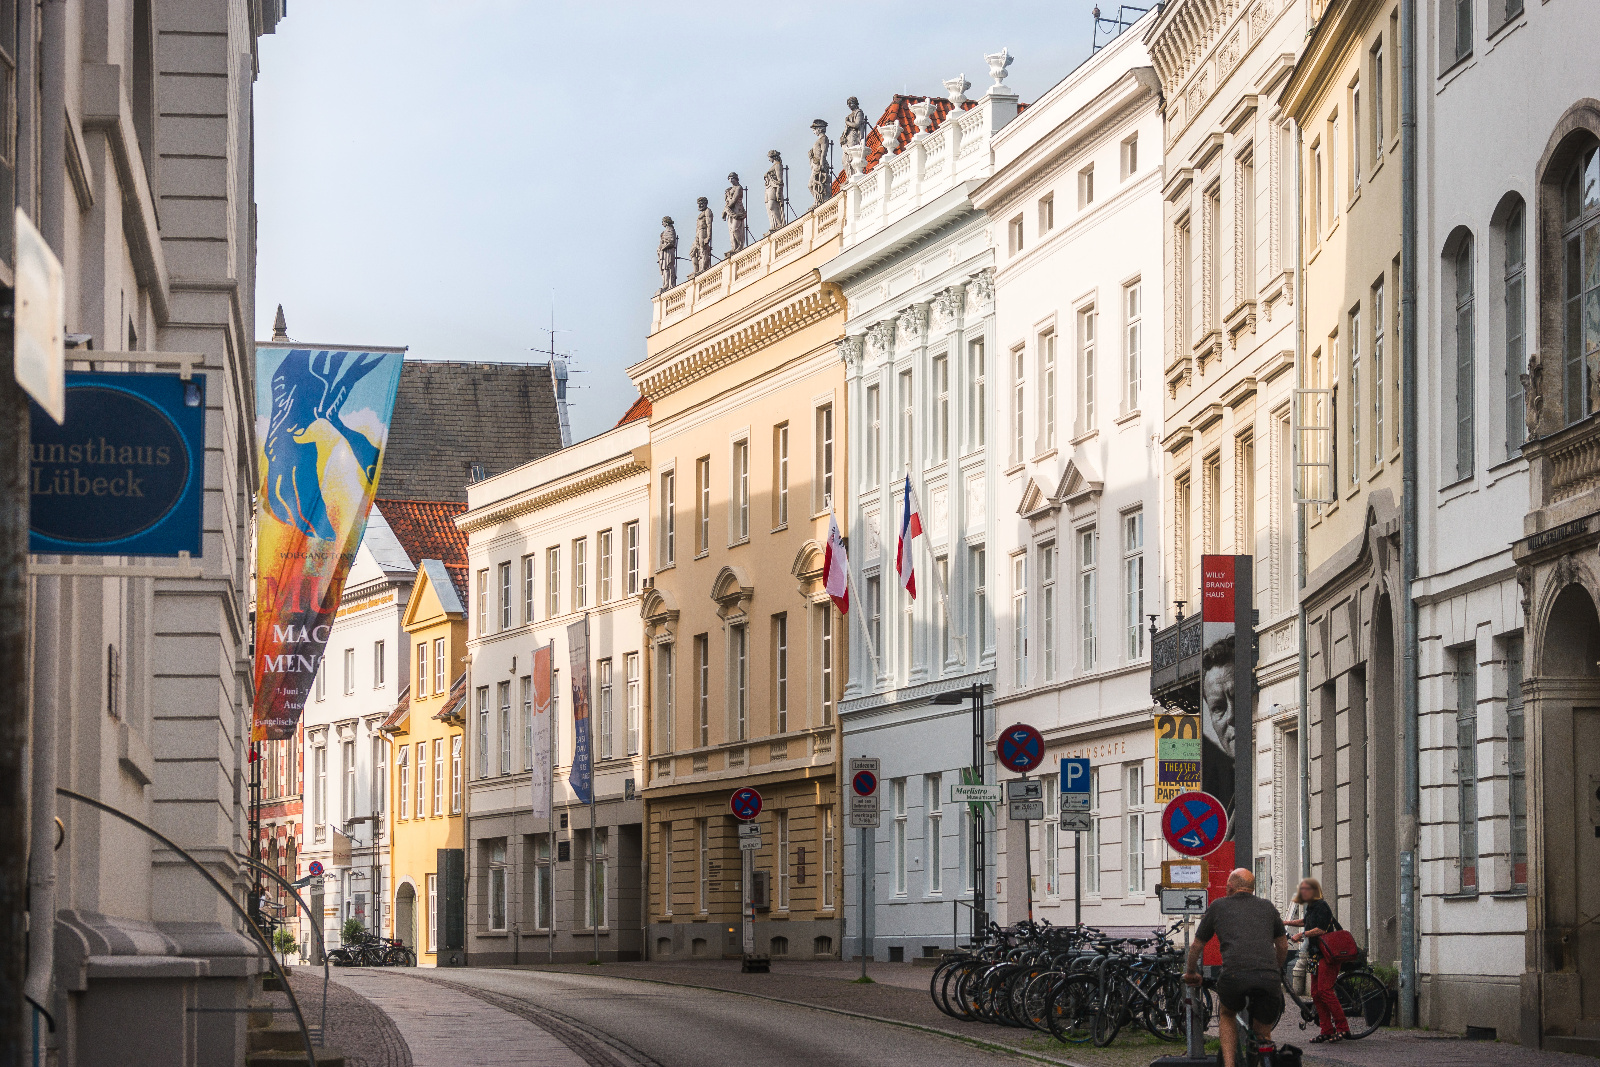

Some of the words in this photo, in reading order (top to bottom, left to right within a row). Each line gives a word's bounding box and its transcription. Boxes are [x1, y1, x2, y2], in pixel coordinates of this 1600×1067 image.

[31, 437, 171, 465] unsthaus
[31, 467, 144, 497] Lübeck
[1205, 571, 1226, 579] WILLY
[1205, 581, 1234, 589] BRANDT
[283, 687, 299, 696] Juni
[1053, 738, 1126, 765] MUSEUMSCAFÉ
[1067, 762, 1083, 789] P
[1164, 762, 1197, 772] THEATER
